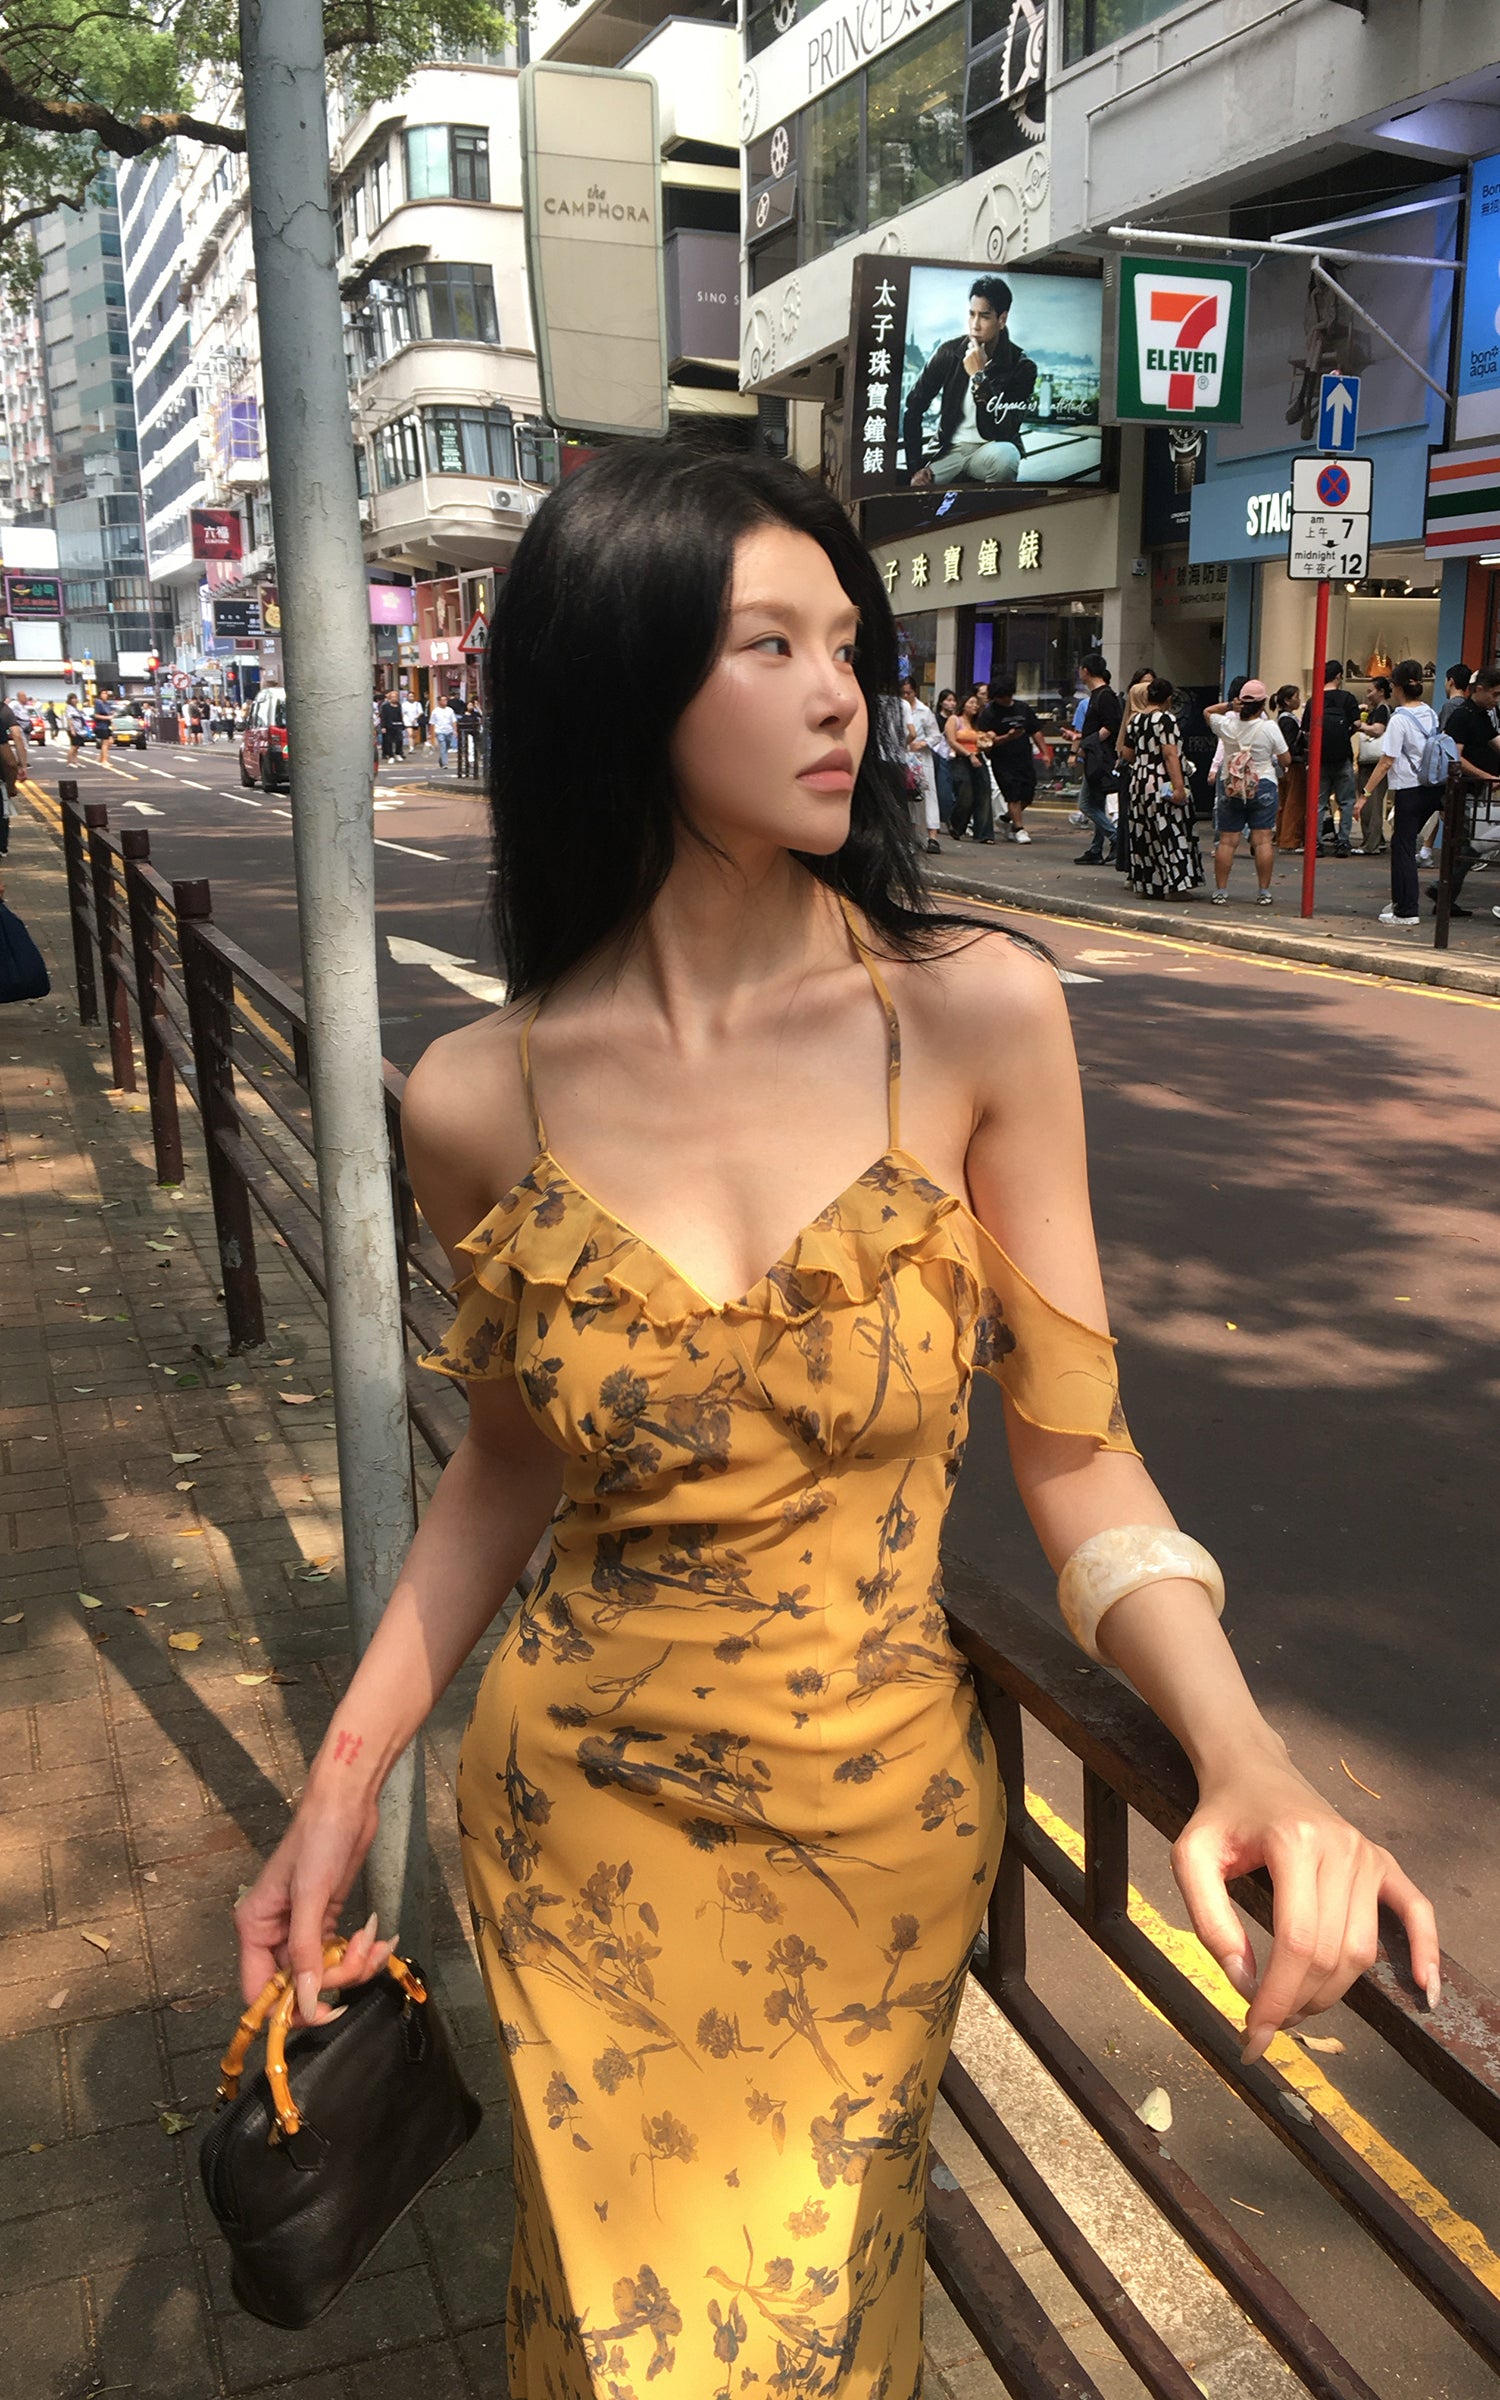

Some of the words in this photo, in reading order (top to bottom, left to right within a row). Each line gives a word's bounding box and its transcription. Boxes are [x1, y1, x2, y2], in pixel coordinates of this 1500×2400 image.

[808, 0, 892, 94] PRINCE
[587, 184, 606, 200] the
[544, 198, 649, 223] CAMPHORA
[697, 290, 727, 304] SINO
[1150, 291, 1218, 411] 7
[1471, 350, 1491, 365] bon
[862, 278, 897, 474] 太子珠寶鐘錶
[1470, 361, 1497, 378] aqua
[1310, 516, 1325, 524] am
[1341, 518, 1354, 539] 7
[1305, 527, 1328, 539] 上午
[883, 529, 1040, 594] 子珠寶鐘錶
[1294, 550, 1336, 562] midnight
[1340, 553, 1362, 575] 12
[1303, 563, 1326, 575] 午夜
